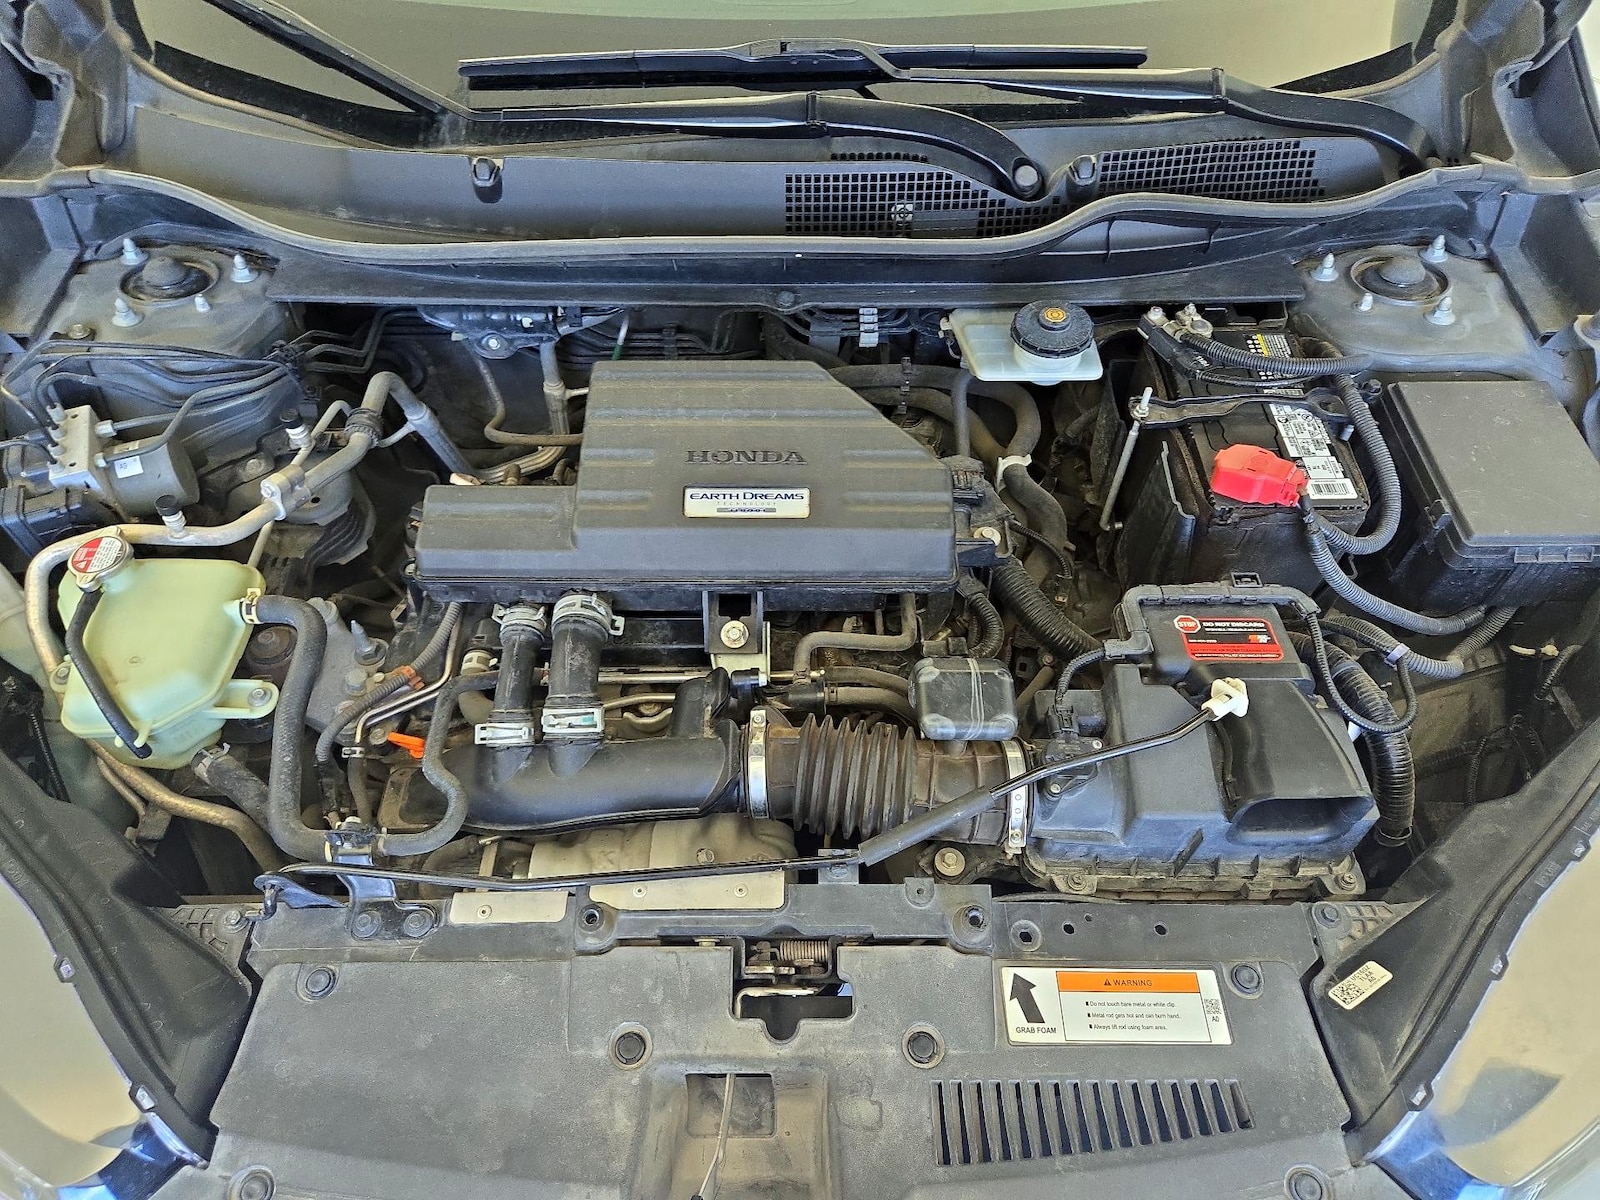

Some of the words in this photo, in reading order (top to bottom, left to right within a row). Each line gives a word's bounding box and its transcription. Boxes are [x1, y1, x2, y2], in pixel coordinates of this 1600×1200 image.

[685, 450, 807, 465] HONDA
[743, 492, 804, 500] DREAMS
[1015, 1026, 1035, 1034] GRAB
[1036, 1026, 1057, 1034] FOAM
